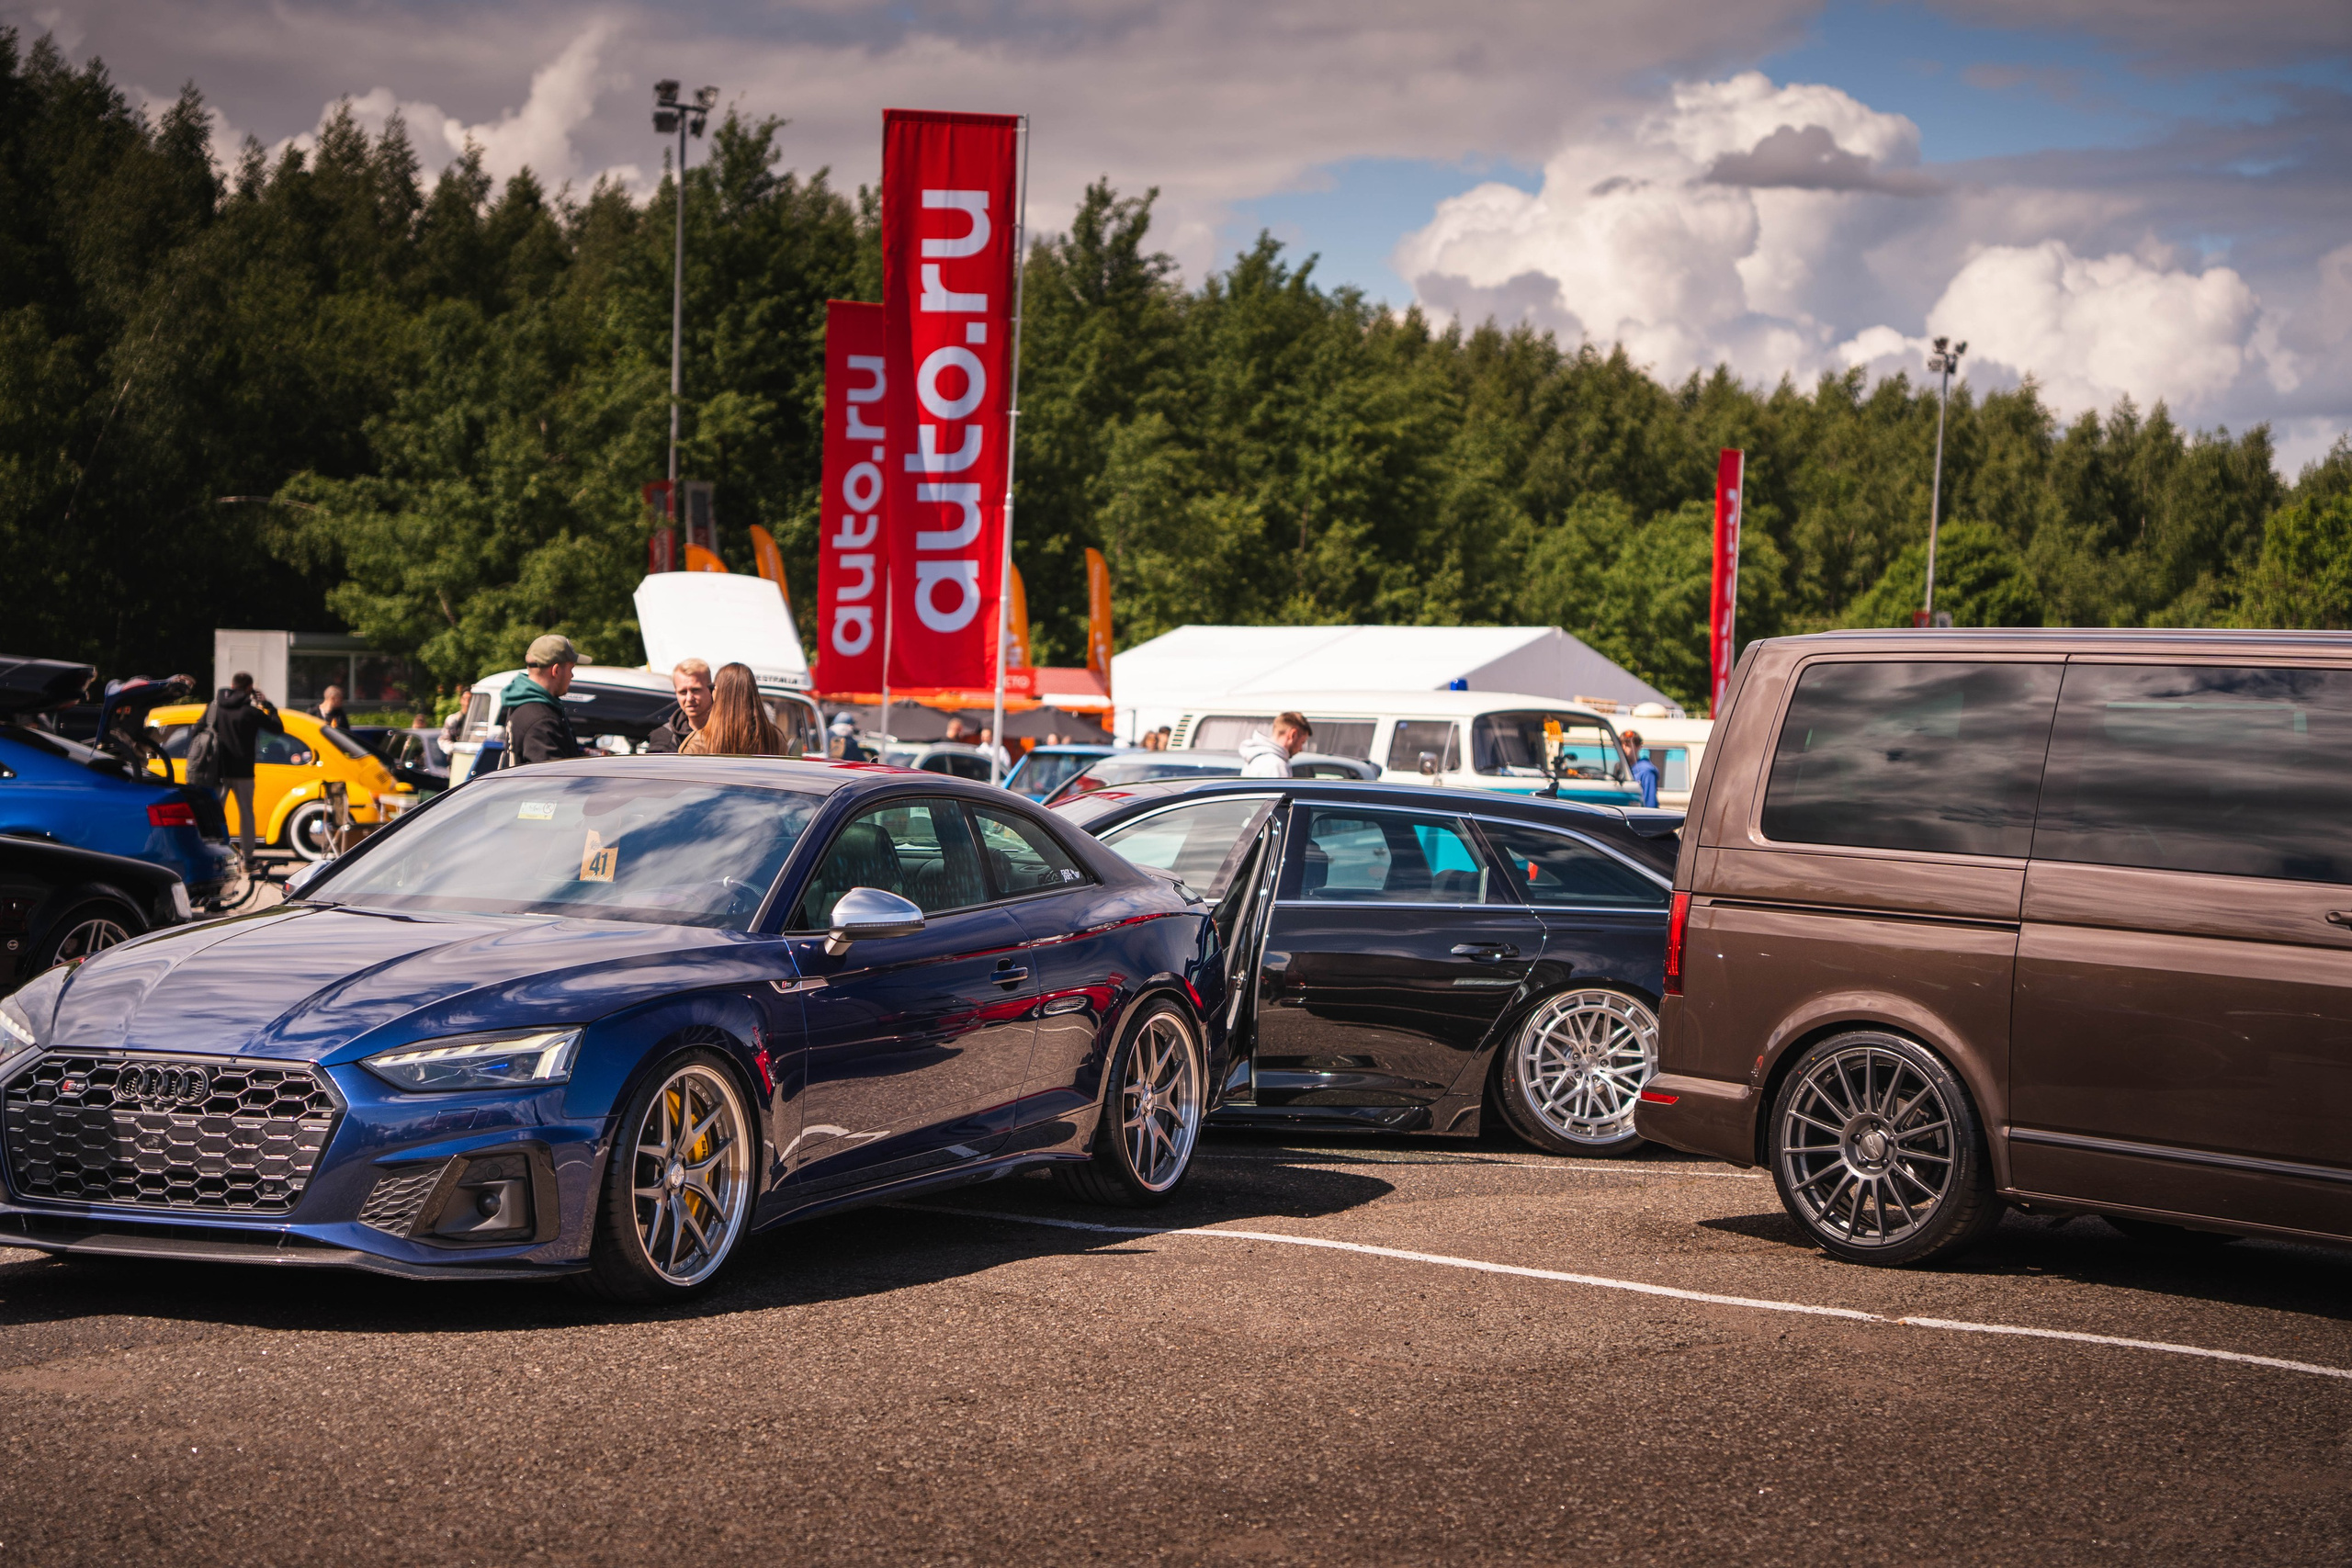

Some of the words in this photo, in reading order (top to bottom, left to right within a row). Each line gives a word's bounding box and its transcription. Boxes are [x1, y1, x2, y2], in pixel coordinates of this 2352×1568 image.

[831, 355, 888, 657] auto.ru
[904, 189, 992, 633] auto.ru
[589, 852, 608, 875] 41
